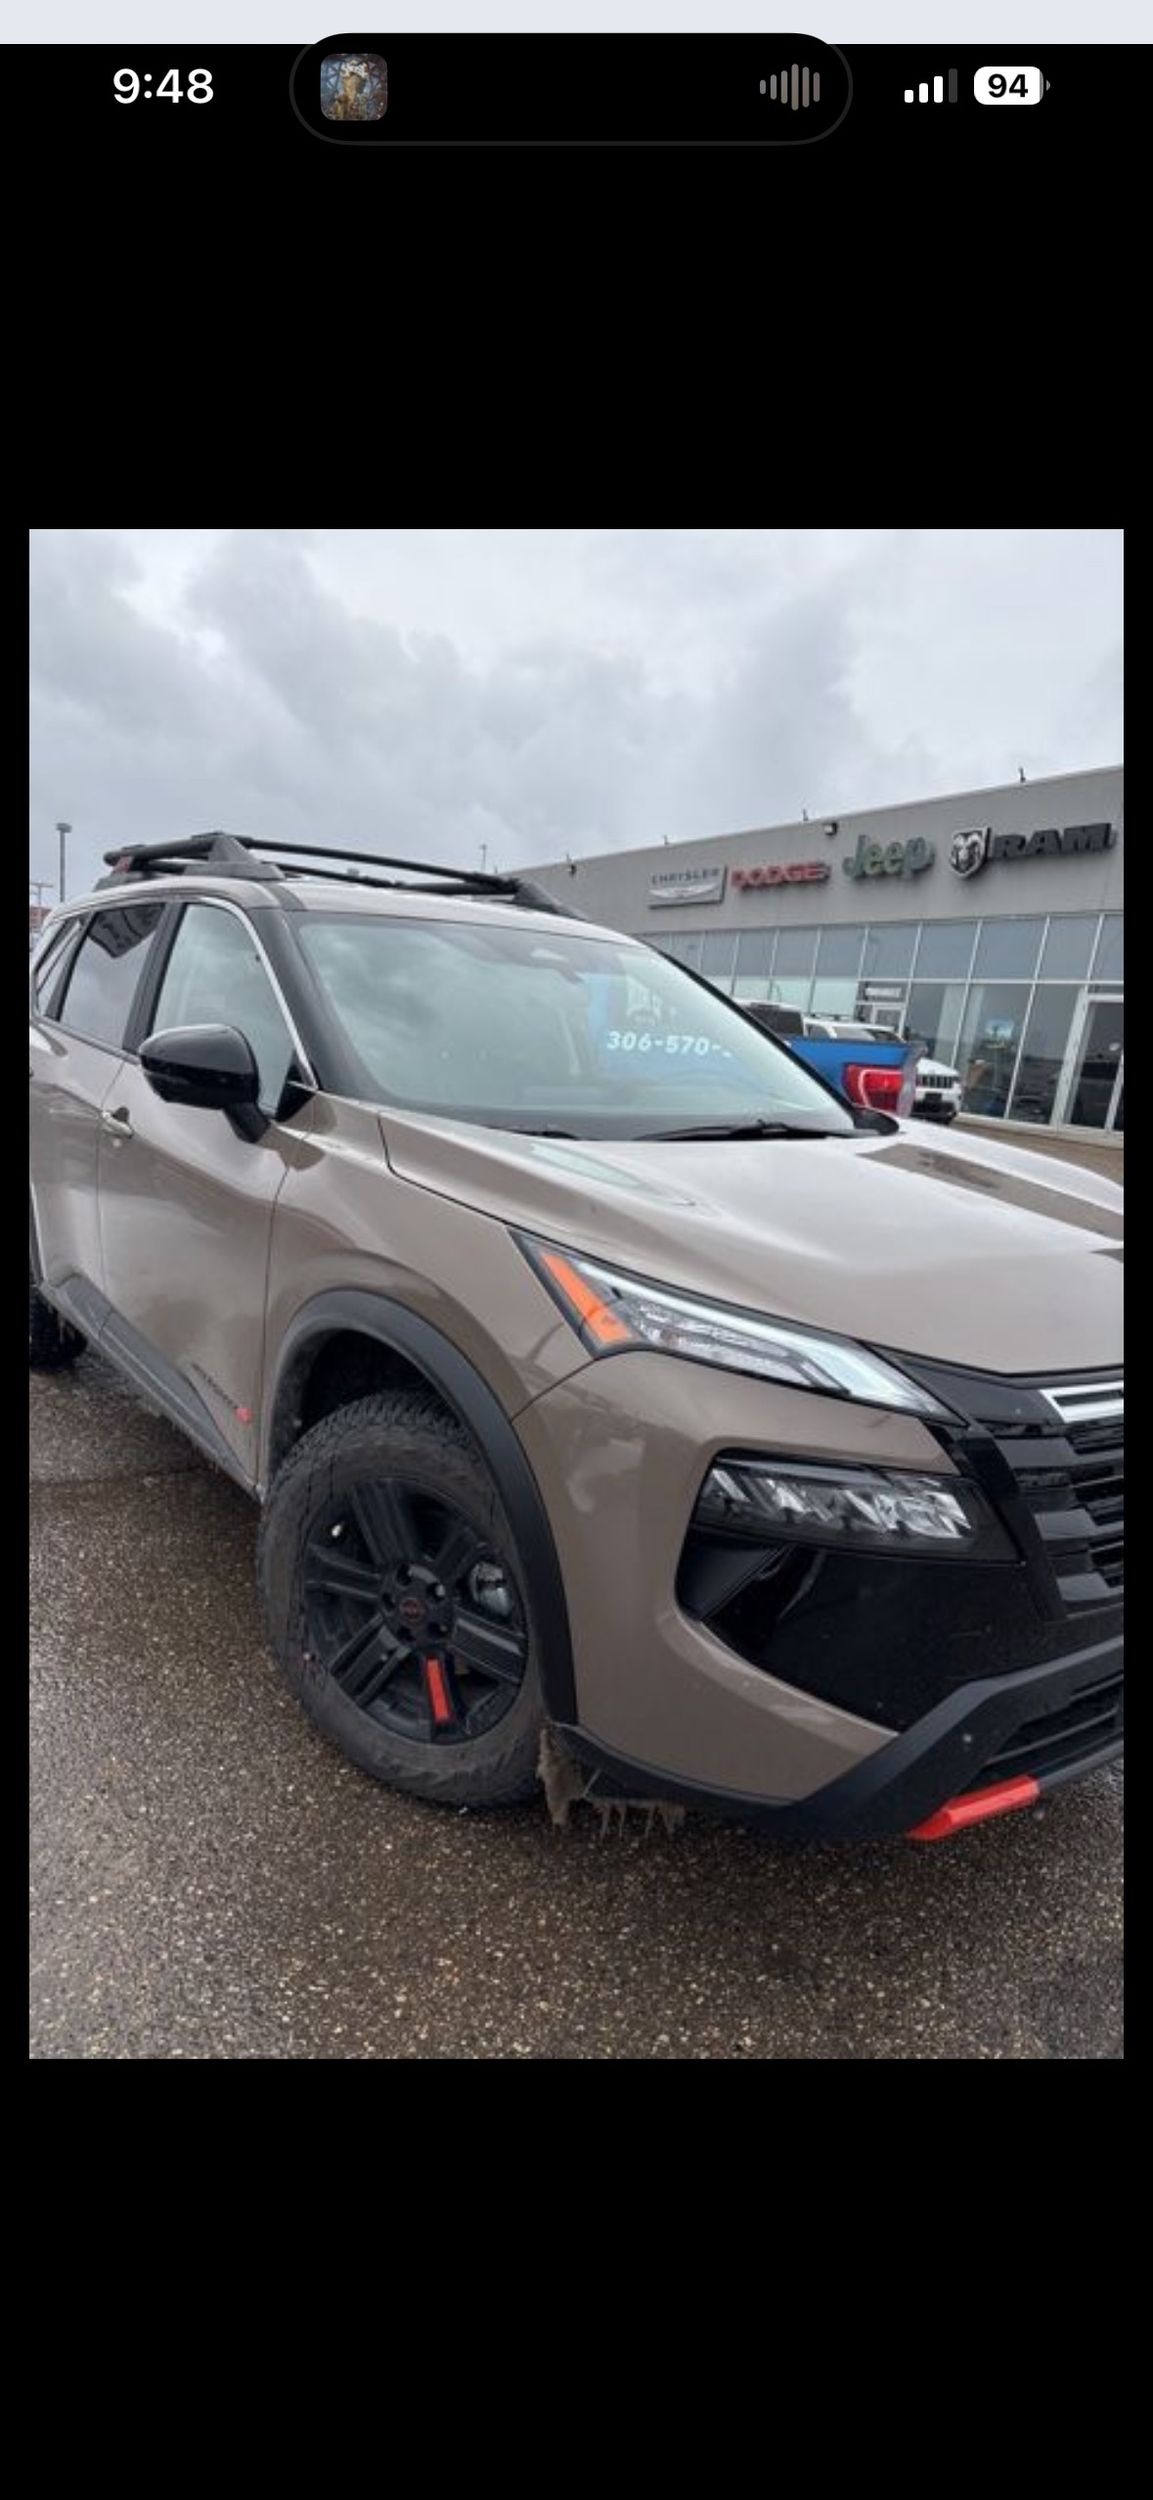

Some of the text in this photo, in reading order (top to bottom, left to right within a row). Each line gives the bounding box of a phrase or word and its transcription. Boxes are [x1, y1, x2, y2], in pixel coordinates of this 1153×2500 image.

[993, 823, 1112, 858] RAM
[842, 834, 932, 879] Jeep
[651, 867, 720, 885] CHRYSLER
[731, 861, 828, 888] DODGE
[607, 1030, 732, 1057] 306-570-
